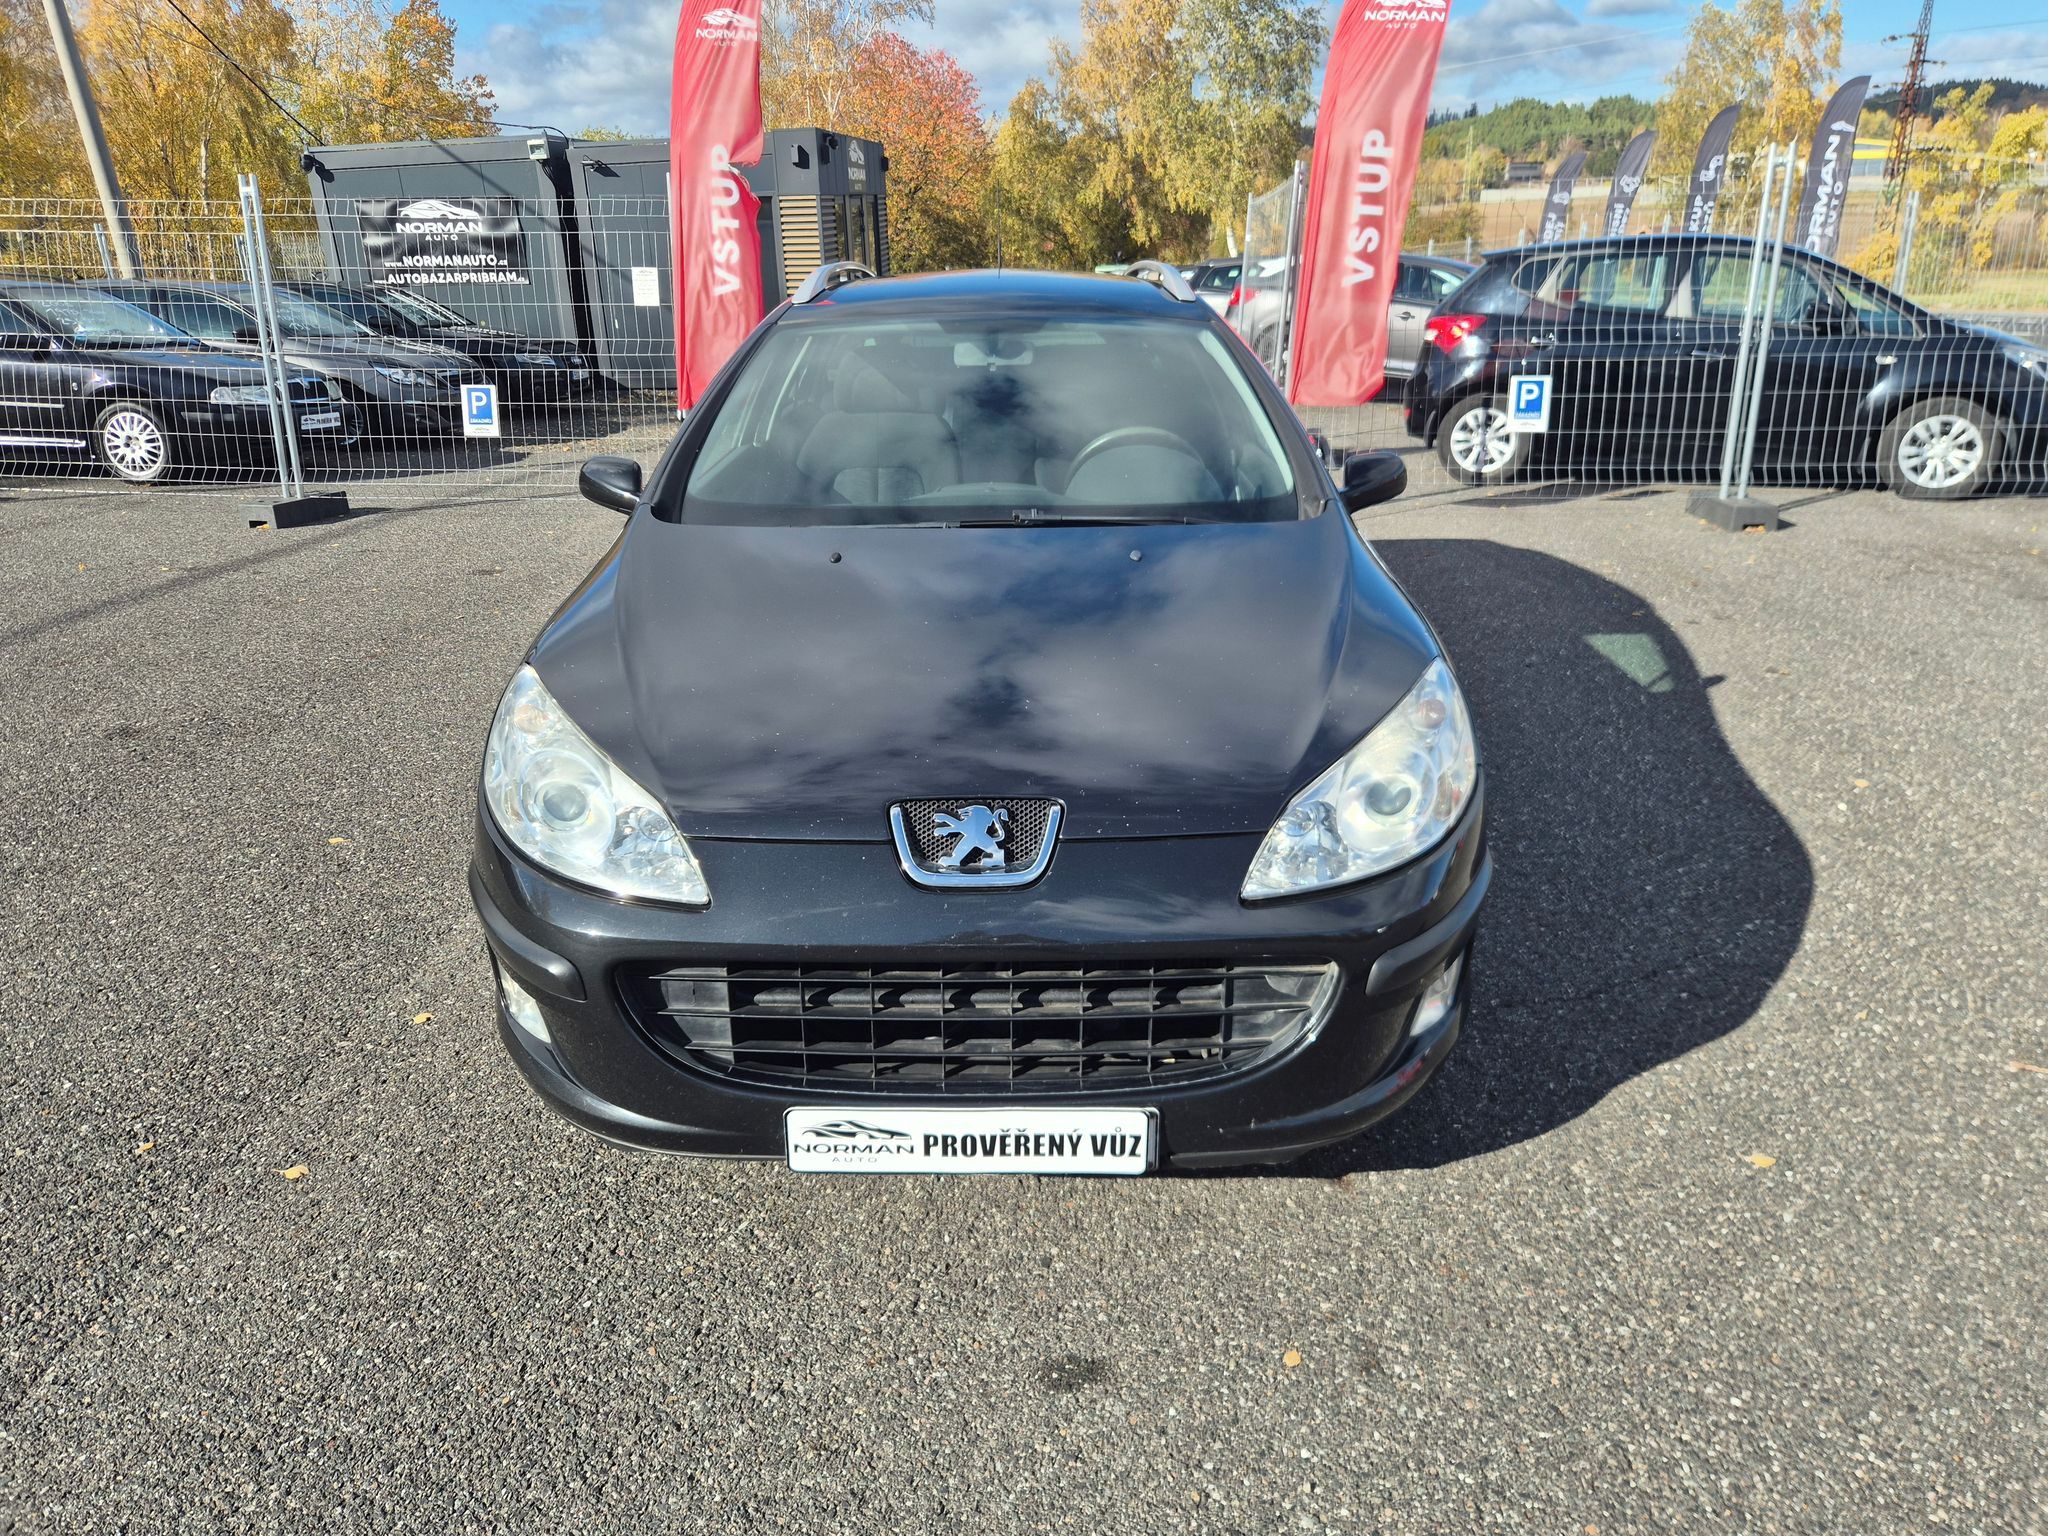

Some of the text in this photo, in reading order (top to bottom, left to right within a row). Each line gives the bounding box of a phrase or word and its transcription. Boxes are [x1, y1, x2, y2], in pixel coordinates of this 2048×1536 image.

[1364, 10, 1446, 22] NORMAN
[696, 28, 758, 41] NORMAN
[1805, 134, 1841, 254] ORMAN
[711, 144, 741, 297] VSTUP
[1341, 129, 1394, 288] VSTUP
[395, 221, 484, 234] NORMAN
[384, 254, 508, 268] www.NORMANAUTO.cz
[470, 391, 488, 415] P
[1519, 382, 1540, 410] P
[793, 1126, 1142, 1158] NORMAN PROVĚŘENÝ VŮZ
[831, 1156, 878, 1164] AUTO
